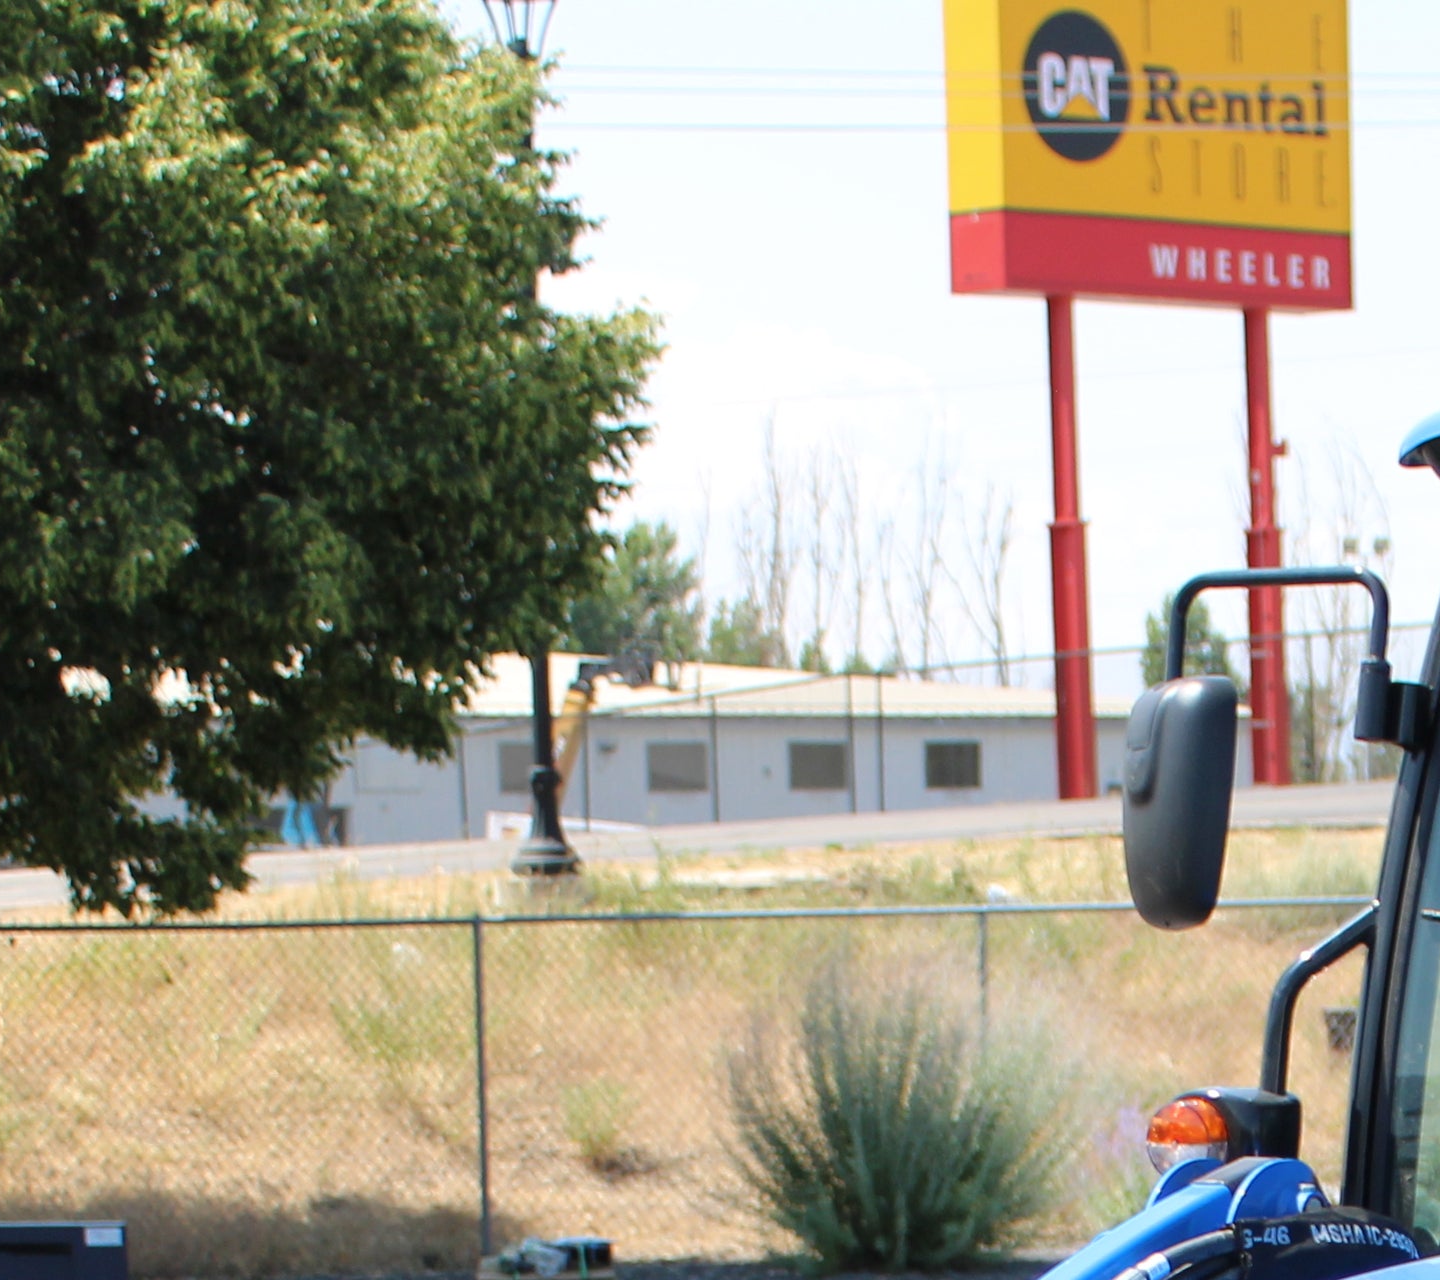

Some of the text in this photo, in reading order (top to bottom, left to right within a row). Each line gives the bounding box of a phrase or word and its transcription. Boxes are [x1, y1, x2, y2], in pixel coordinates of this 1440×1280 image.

[1036, 51, 1116, 122] CAT
[1142, 63, 1330, 138] Rental
[1148, 136, 1335, 209] STORE
[1149, 243, 1332, 290] WHEELER
